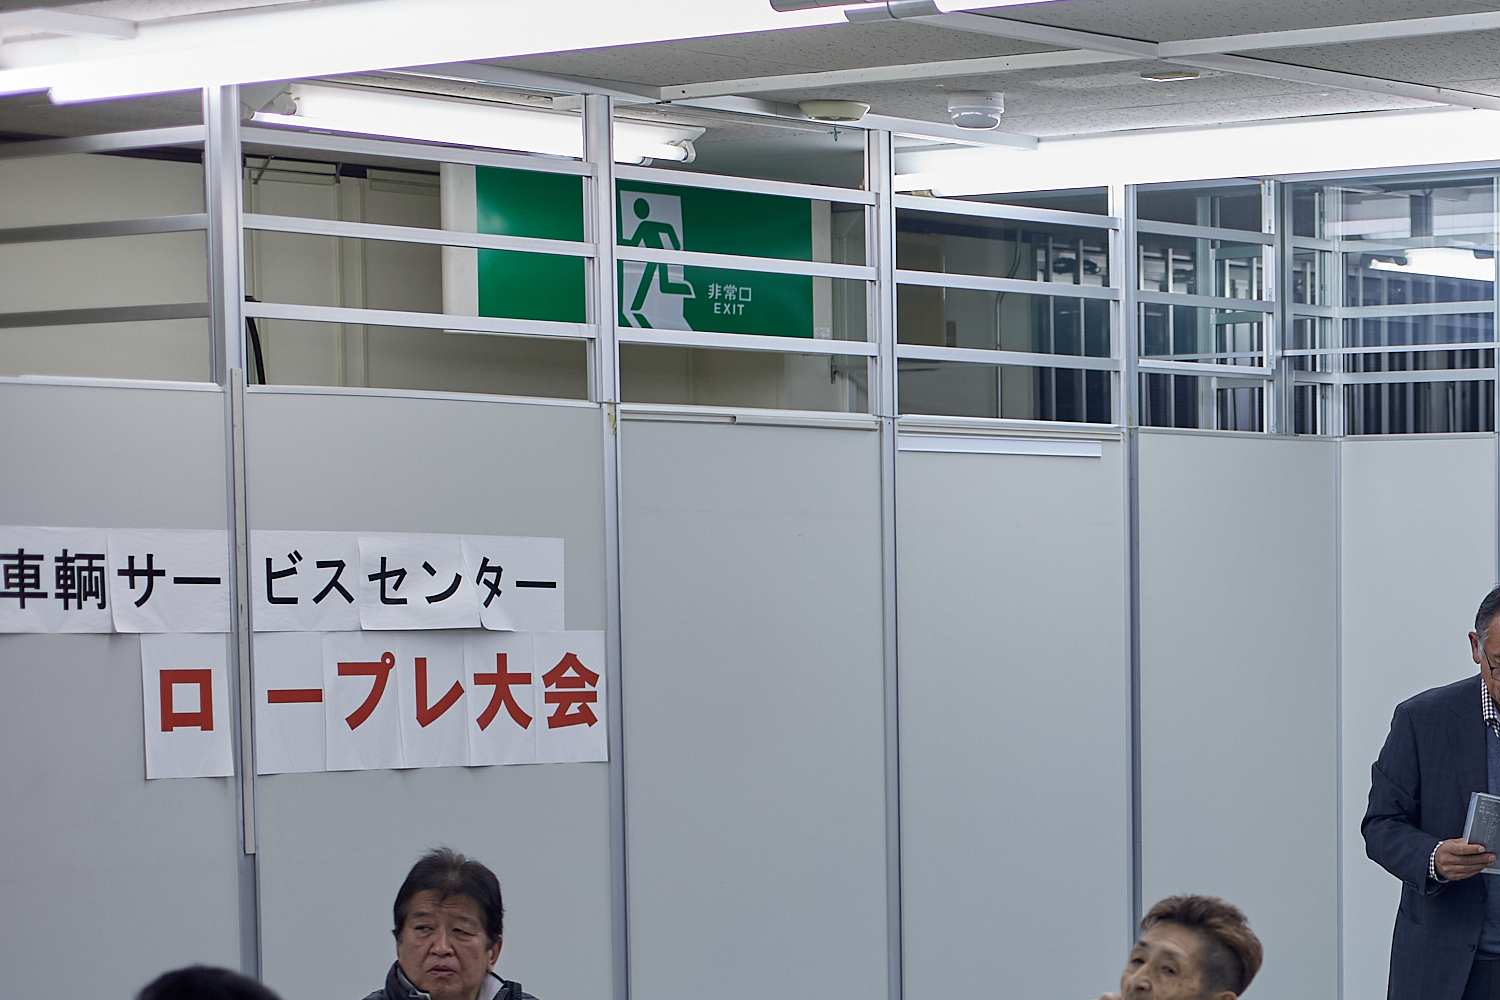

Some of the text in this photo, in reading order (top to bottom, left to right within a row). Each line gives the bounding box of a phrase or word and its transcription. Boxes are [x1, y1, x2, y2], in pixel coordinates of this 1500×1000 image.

[708, 283, 752, 302] 非常口
[714, 302, 745, 316] EXIT
[159, 651, 600, 732] ロープレ大会
